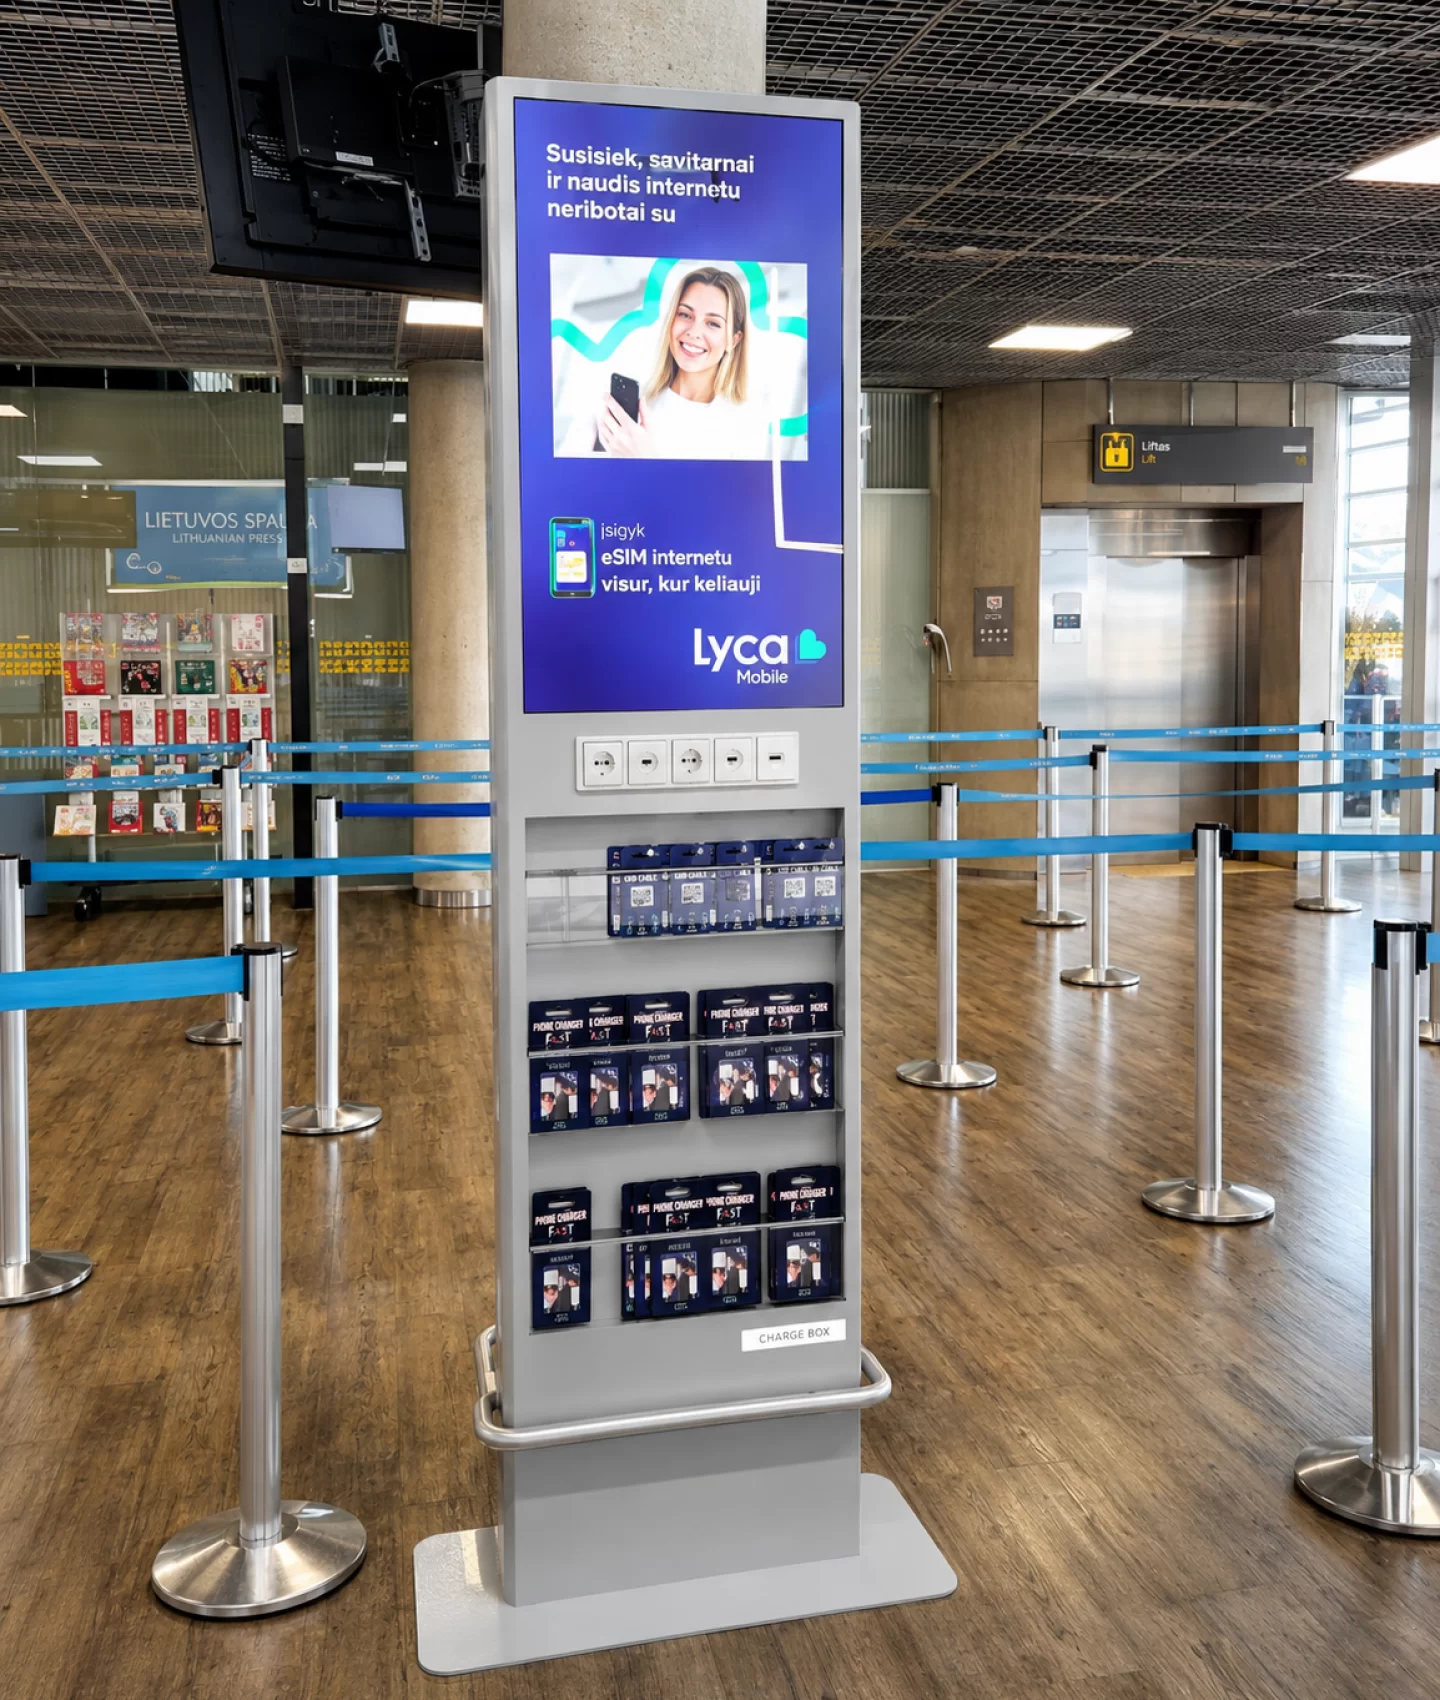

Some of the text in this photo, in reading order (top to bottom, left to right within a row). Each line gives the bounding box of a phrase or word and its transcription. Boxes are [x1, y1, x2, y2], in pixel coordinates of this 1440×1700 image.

[546, 143, 755, 173] Susisiek, savitarnai
[547, 170, 741, 199] ir naudis internetu
[547, 200, 676, 223] neribotai su
[145, 511, 239, 529] LIETUVOS
[172, 533, 283, 544] LITHUANIAN PRESS
[601, 548, 732, 566] eSIM internetu
[601, 574, 761, 596] visur, kur keliauji
[694, 628, 788, 672] Lyca
[737, 669, 789, 684] Mobile
[716, 1206, 742, 1221] FAST
[759, 1327, 831, 1344] CHARGE BOX
